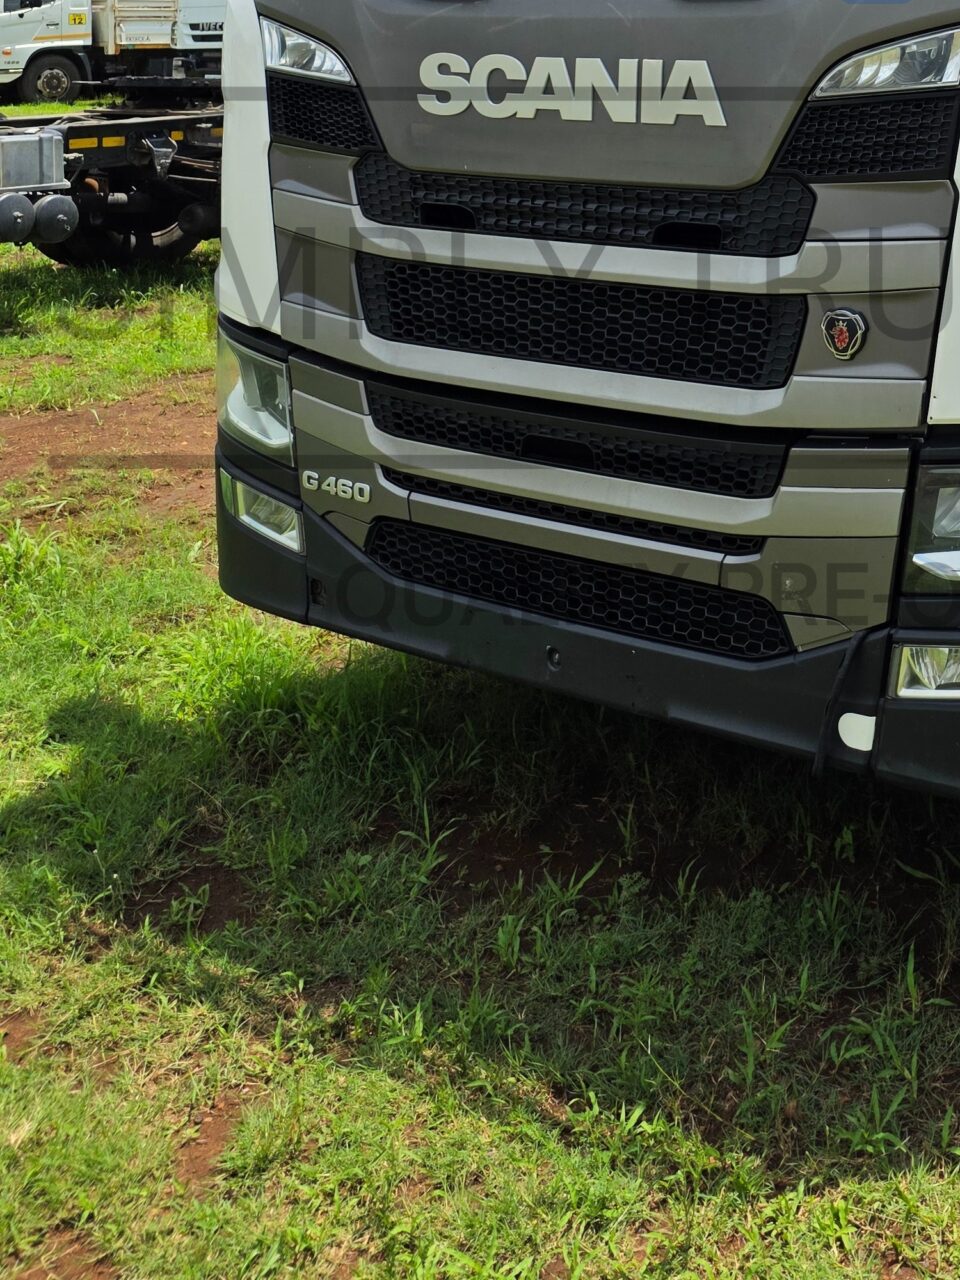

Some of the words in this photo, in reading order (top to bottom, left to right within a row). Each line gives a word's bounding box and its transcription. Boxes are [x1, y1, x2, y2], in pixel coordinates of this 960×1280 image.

[199, 21, 224, 32] IVEC
[416, 52, 728, 127] SCANIA
[302, 470, 319, 491] G
[321, 476, 371, 504] 460
